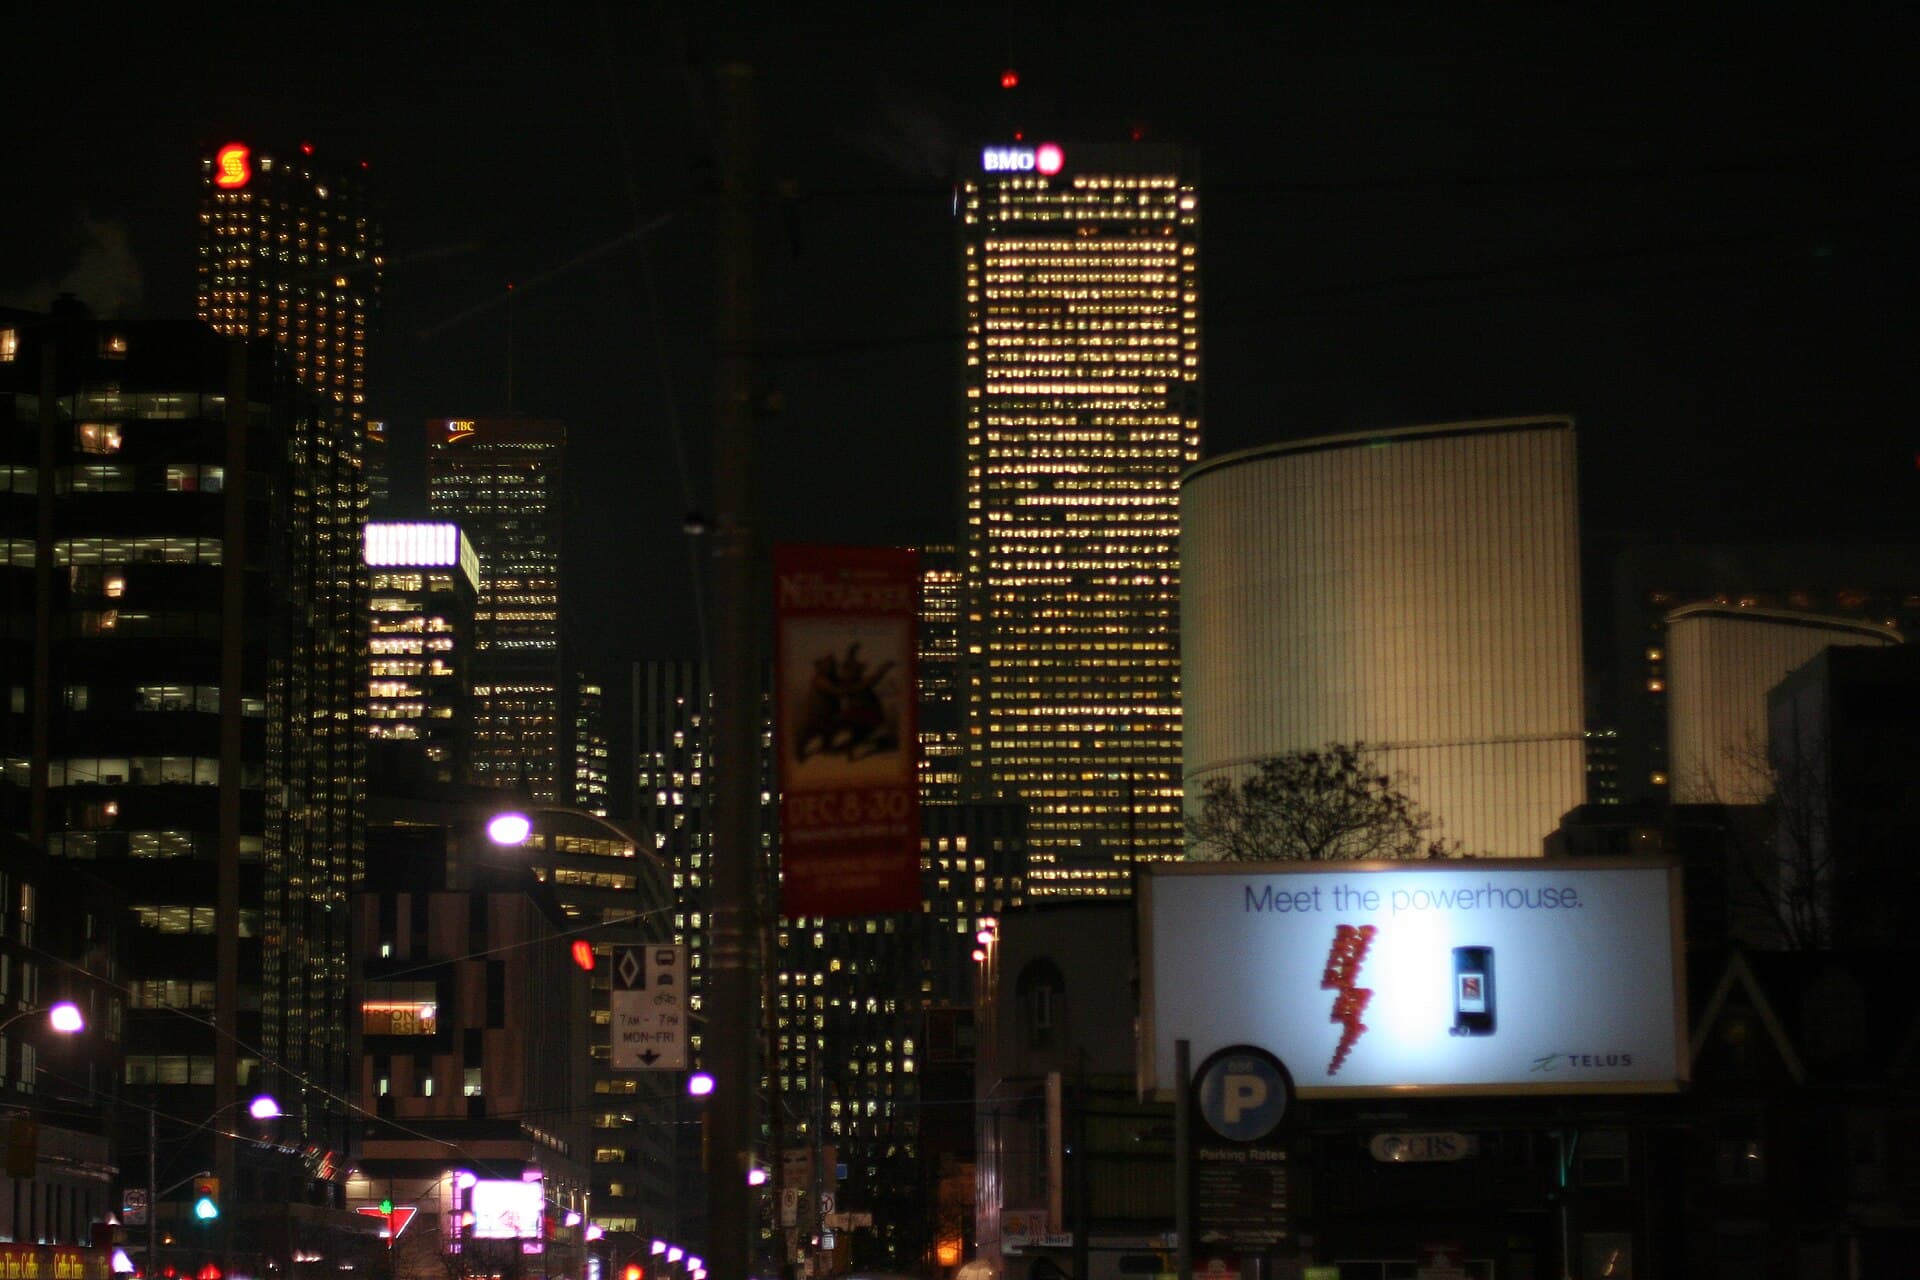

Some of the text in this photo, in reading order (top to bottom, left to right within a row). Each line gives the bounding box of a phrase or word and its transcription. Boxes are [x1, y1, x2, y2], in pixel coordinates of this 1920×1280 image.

[983, 148, 1035, 171] BMO
[449, 421, 475, 432] CIBC
[1245, 883, 1583, 915] Meet the powerhouse.
[624, 1032, 674, 1043] MON-FRI
[1568, 1054, 1632, 1068] TELUS
[1224, 1075, 1268, 1123] P
[1407, 1134, 1457, 1158] CBS
[1200, 1149, 1287, 1163] Parking Rates
